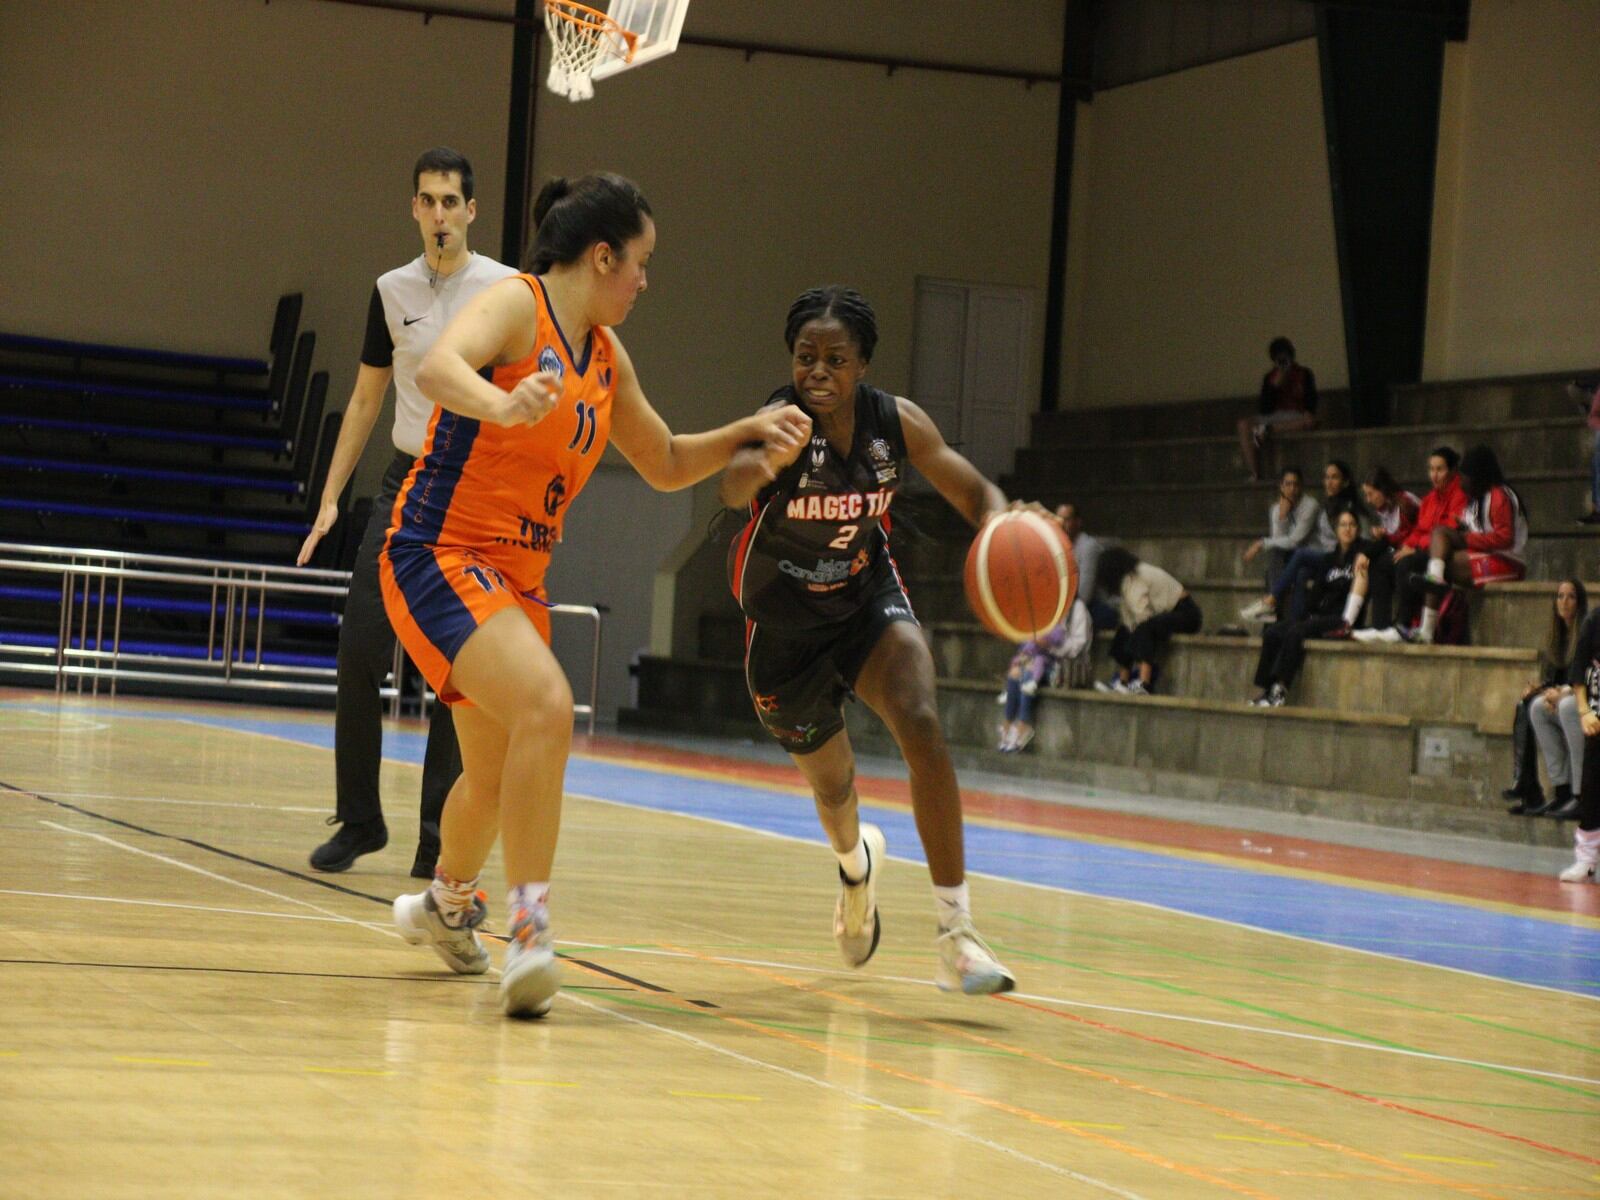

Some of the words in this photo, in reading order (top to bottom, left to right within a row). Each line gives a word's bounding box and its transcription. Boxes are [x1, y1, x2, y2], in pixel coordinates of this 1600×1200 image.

[568, 400, 597, 456] 11
[786, 493, 863, 520] MAGEC
[828, 524, 859, 550] 2
